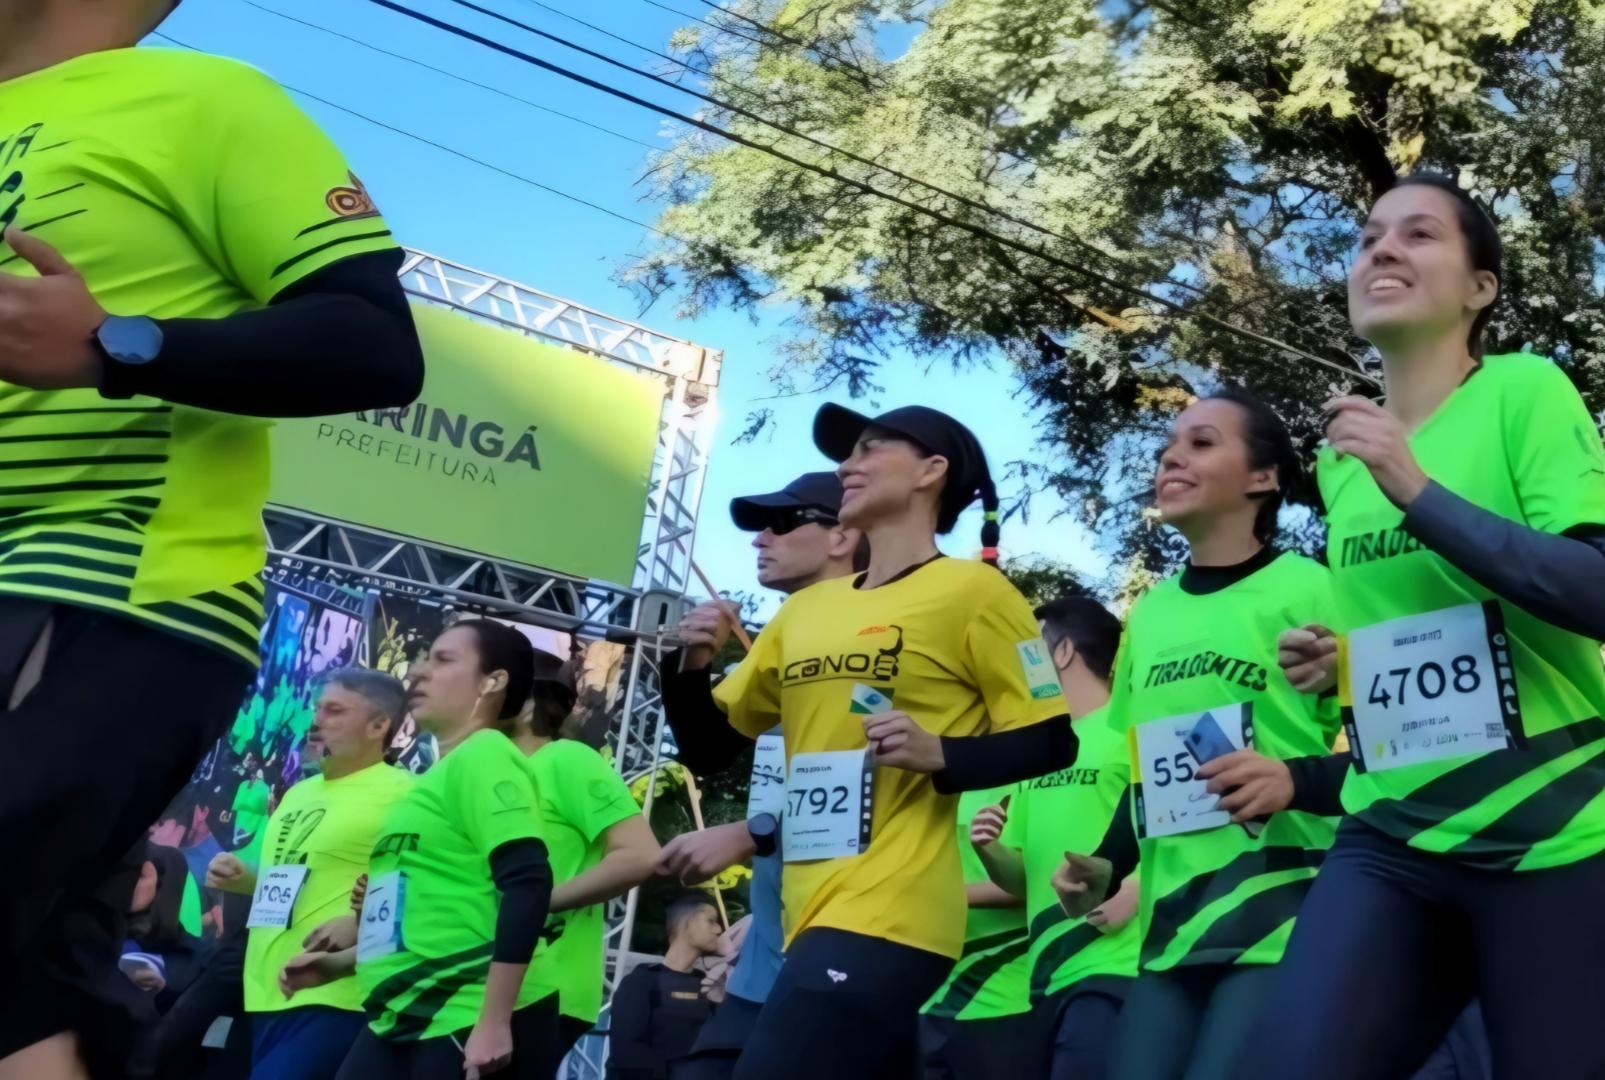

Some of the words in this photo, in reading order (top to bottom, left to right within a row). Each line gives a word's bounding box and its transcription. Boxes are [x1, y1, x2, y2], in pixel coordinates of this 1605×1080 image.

[317, 423, 496, 486] PREFEITURA
[356, 402, 541, 472] RINGÁ
[1368, 655, 1481, 710] 4708
[1154, 752, 1194, 787] 55
